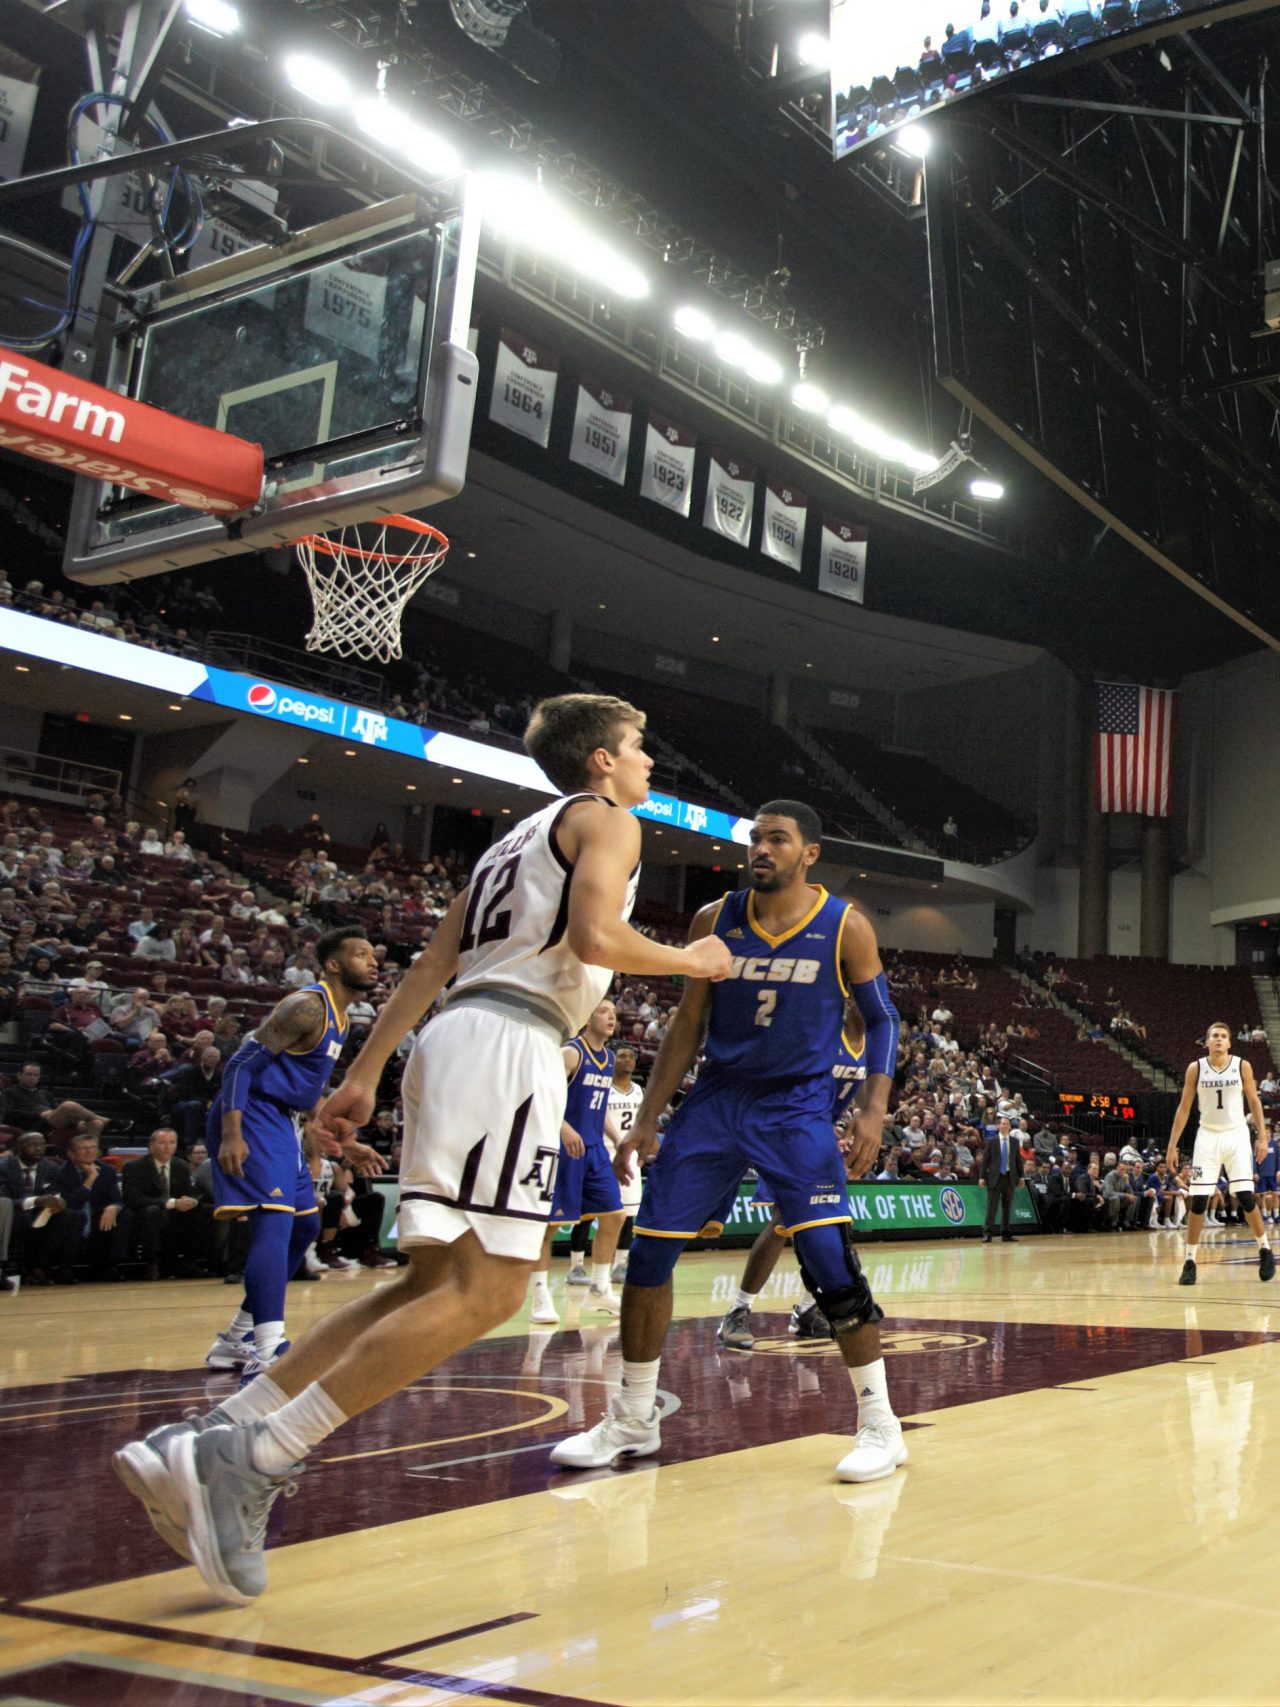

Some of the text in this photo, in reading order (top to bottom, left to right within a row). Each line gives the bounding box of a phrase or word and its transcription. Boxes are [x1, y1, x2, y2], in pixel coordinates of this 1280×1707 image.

[322, 288, 371, 328] 1975
[0, 361, 126, 444] Farm
[504, 383, 543, 420] 1964
[584, 426, 617, 458] 1951
[652, 461, 684, 492] 1923
[716, 494, 744, 522] 1922
[772, 522, 795, 548] 1921
[828, 558, 858, 582] 1920
[278, 697, 333, 724] pepsi
[459, 853, 522, 954] 12
[754, 989, 778, 1028] 2
[1201, 1081, 1224, 1089] TEXAS
[589, 1090, 605, 1110] 21
[608, 1102, 631, 1110] TEXAS
[1091, 1096, 1110, 1108] 2:58
[1216, 1089, 1224, 1110] 1
[621, 1111, 633, 1130] 2
[810, 1195, 841, 1205] UCSB
[875, 1195, 896, 1219] OF
[900, 1195, 936, 1219] THE
[943, 1190, 964, 1221] SEC
